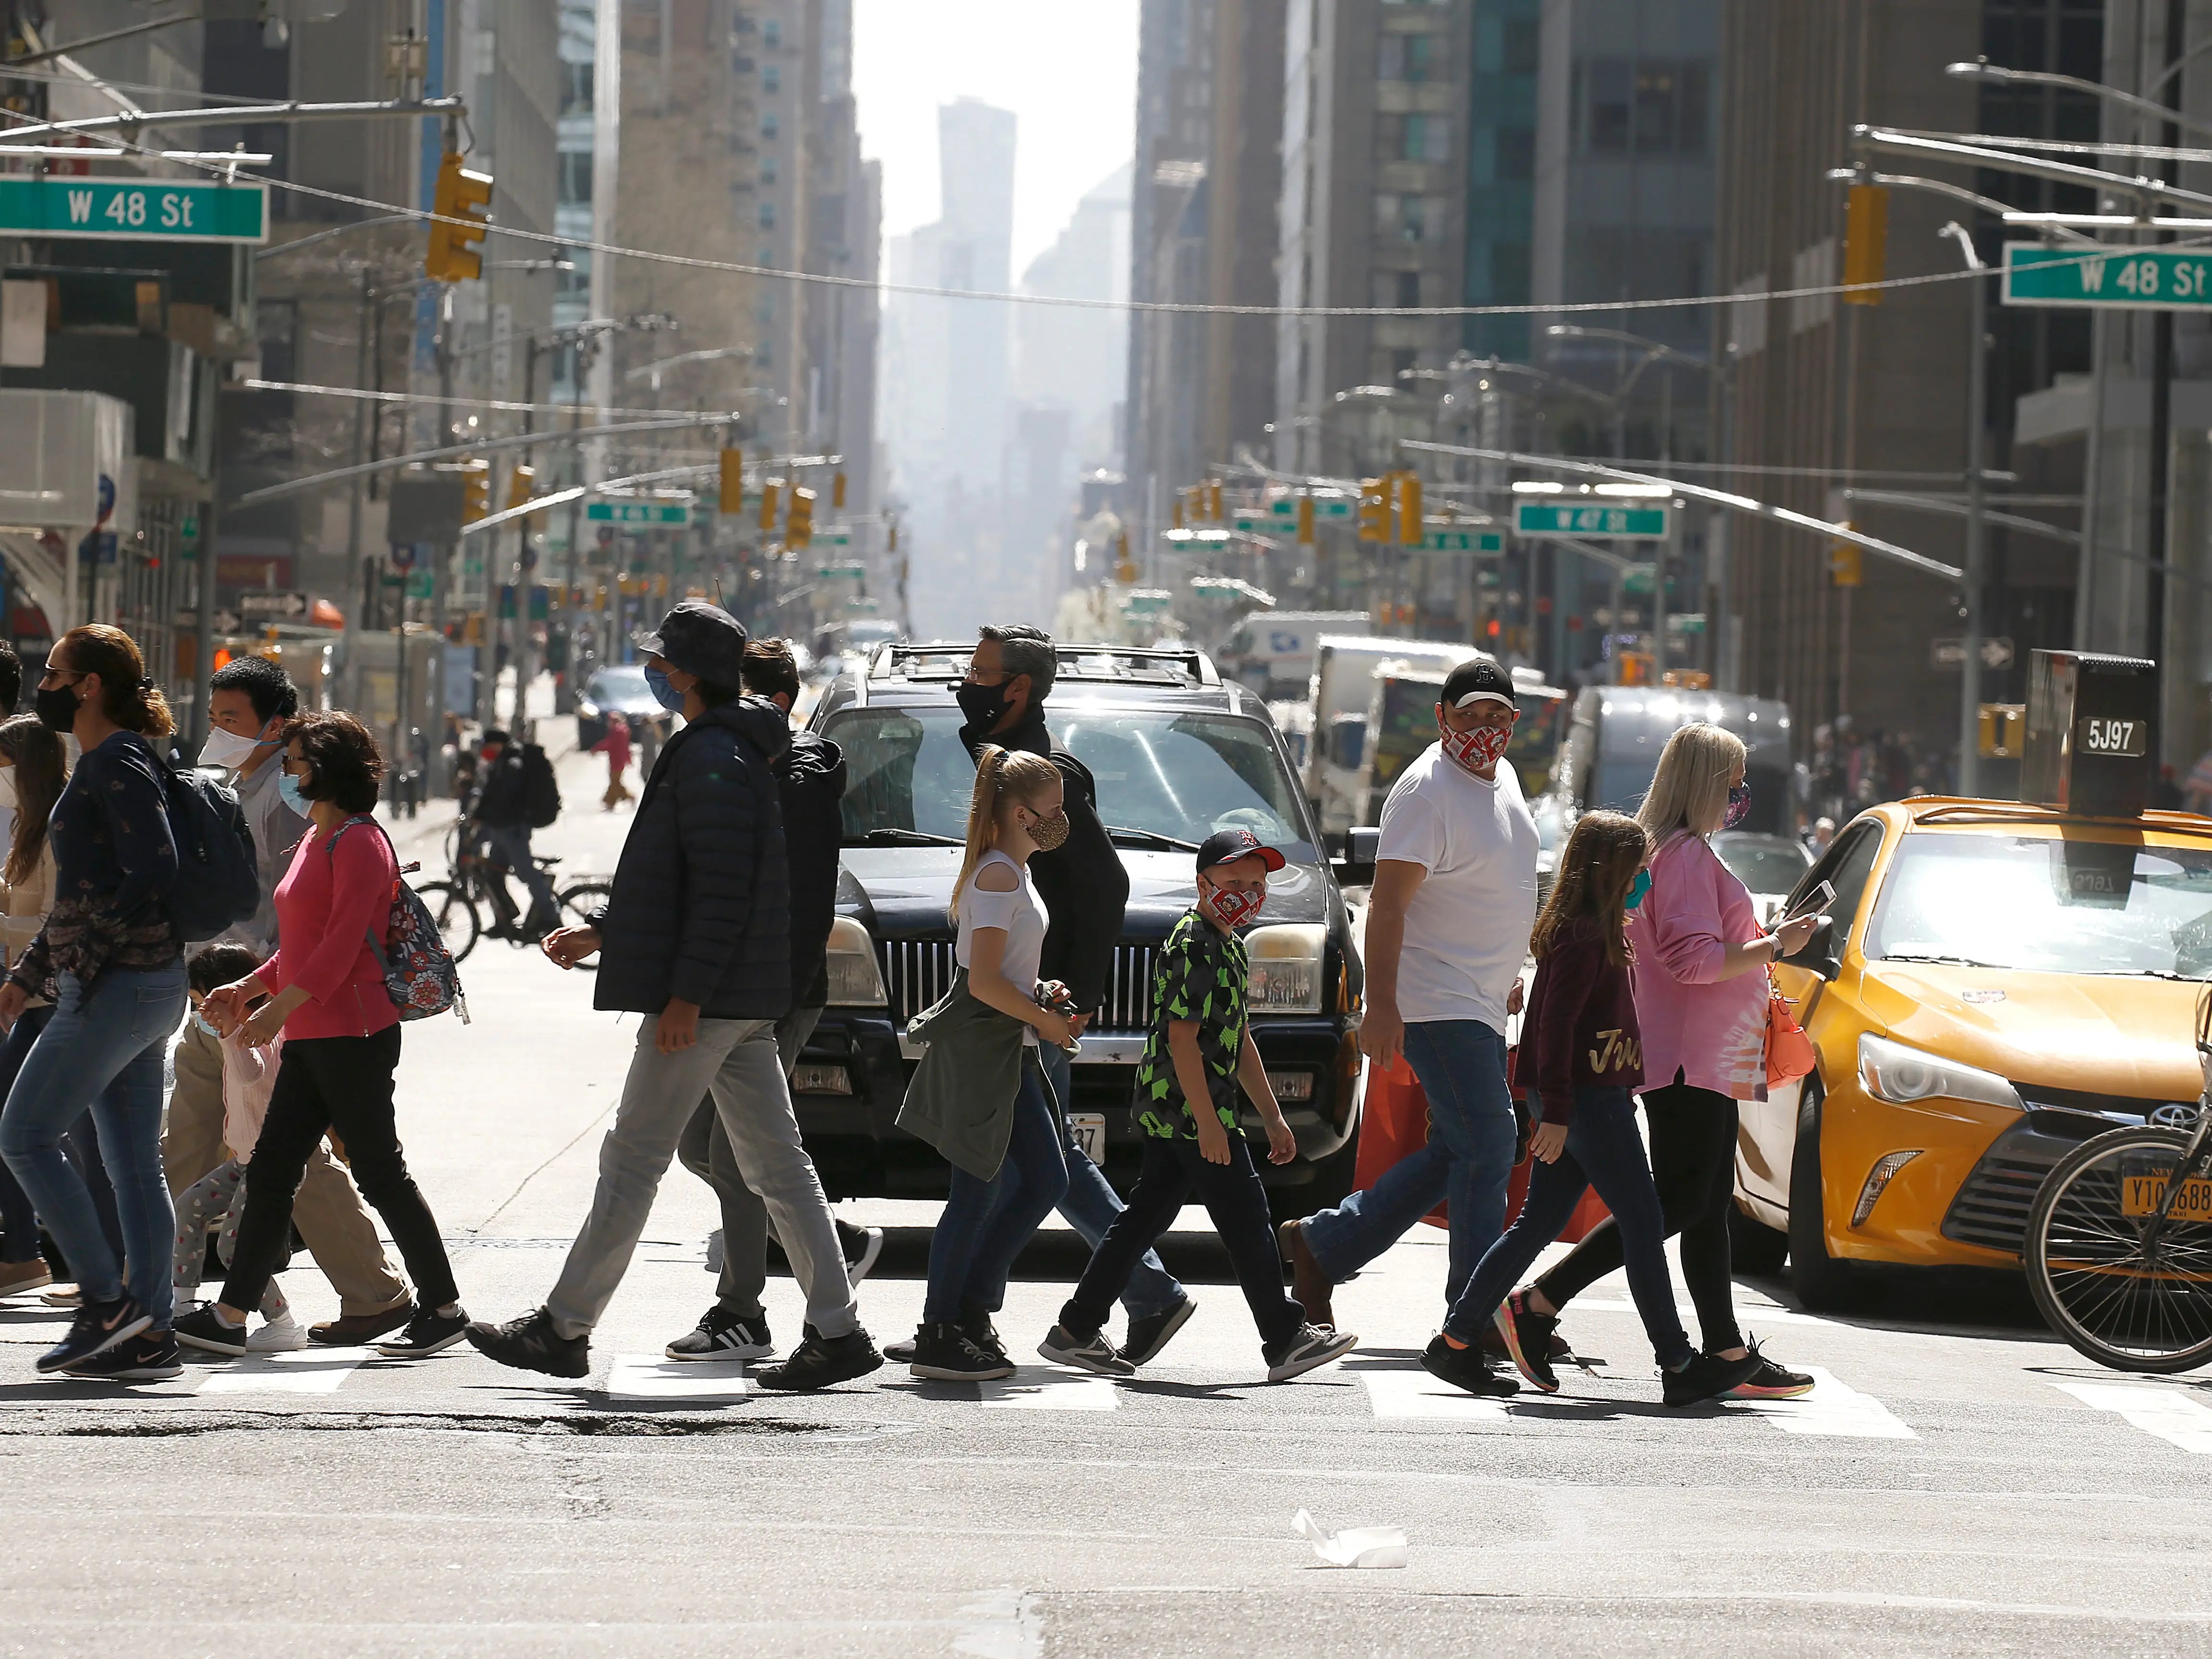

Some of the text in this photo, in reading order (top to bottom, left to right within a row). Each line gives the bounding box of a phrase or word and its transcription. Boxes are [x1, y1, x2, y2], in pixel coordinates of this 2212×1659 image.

[68, 190, 194, 228] W 48 St
[2079, 258, 2206, 296] W 48 St
[1475, 663, 1493, 684] B
[2089, 720, 2134, 750] 5J97
[2133, 1179, 2211, 1211] Y10688
